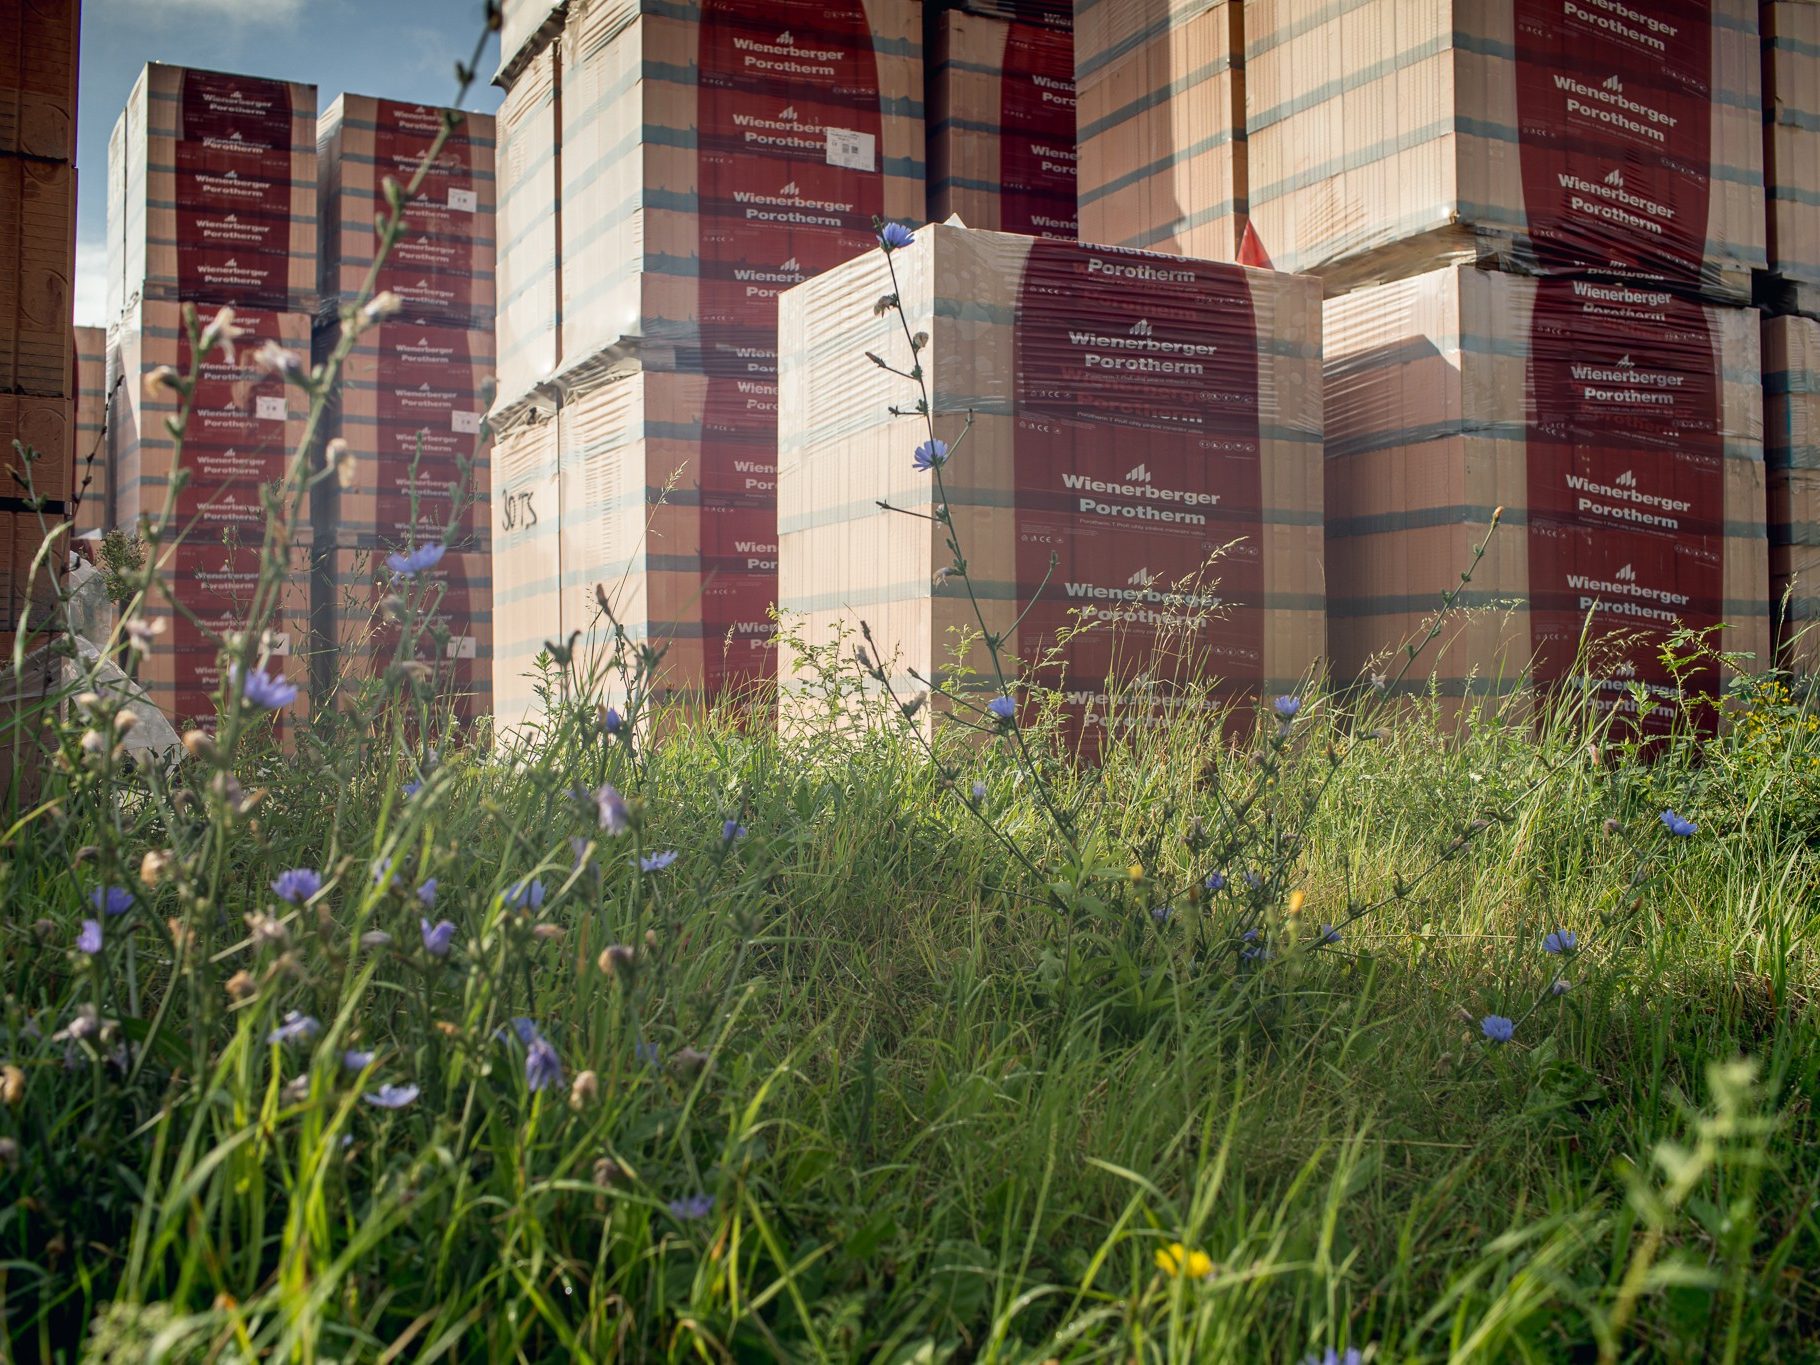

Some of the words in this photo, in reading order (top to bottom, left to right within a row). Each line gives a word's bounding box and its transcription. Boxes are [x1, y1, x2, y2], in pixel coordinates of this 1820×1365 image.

[1564, 1, 1665, 52] Porotherm
[1587, 0, 1678, 36] nerberger
[733, 37, 844, 61] Wienerberger
[744, 56, 835, 76] Porotherm
[1553, 74, 1678, 128] Wienerberger
[733, 113, 830, 136] Wienerber
[1567, 98, 1665, 142] Porotherm
[745, 131, 827, 150] Porother
[195, 175, 271, 189] Wienerberger
[203, 184, 263, 197] Porotherm
[733, 190, 853, 213] Wienerberger
[1558, 173, 1676, 219] Wienerberger
[196, 219, 270, 233] Wienerberger
[746, 208, 842, 227] Porotherm
[1571, 196, 1663, 235] Porotherm
[203, 230, 262, 241] Porotherm
[399, 252, 449, 263] Porotherm
[197, 265, 269, 277] Wienerberger
[204, 275, 261, 285] Porotherm
[1088, 258, 1196, 282] Porotherm
[393, 285, 455, 298] Wienerberger
[1572, 280, 1672, 306] Wienerberger
[395, 344, 453, 354] Wienerberger
[1068, 331, 1217, 356] Wienerberger
[401, 354, 449, 363] Porotherm
[1085, 353, 1204, 375] Porotherm
[1571, 365, 1684, 387] Wienerberger
[395, 389, 457, 399] Wienerberger
[401, 399, 452, 408] Porotherm
[1584, 387, 1675, 405] Porotherm
[197, 456, 266, 466] Wienerberger
[1062, 473, 1220, 505] Wienerberger
[1566, 474, 1692, 513] Wienerberger
[1079, 498, 1206, 525] Porotherm
[1578, 498, 1679, 529] Porotherm
[1567, 574, 1690, 606] Wienerberger
[1579, 597, 1677, 622] Porotherm
